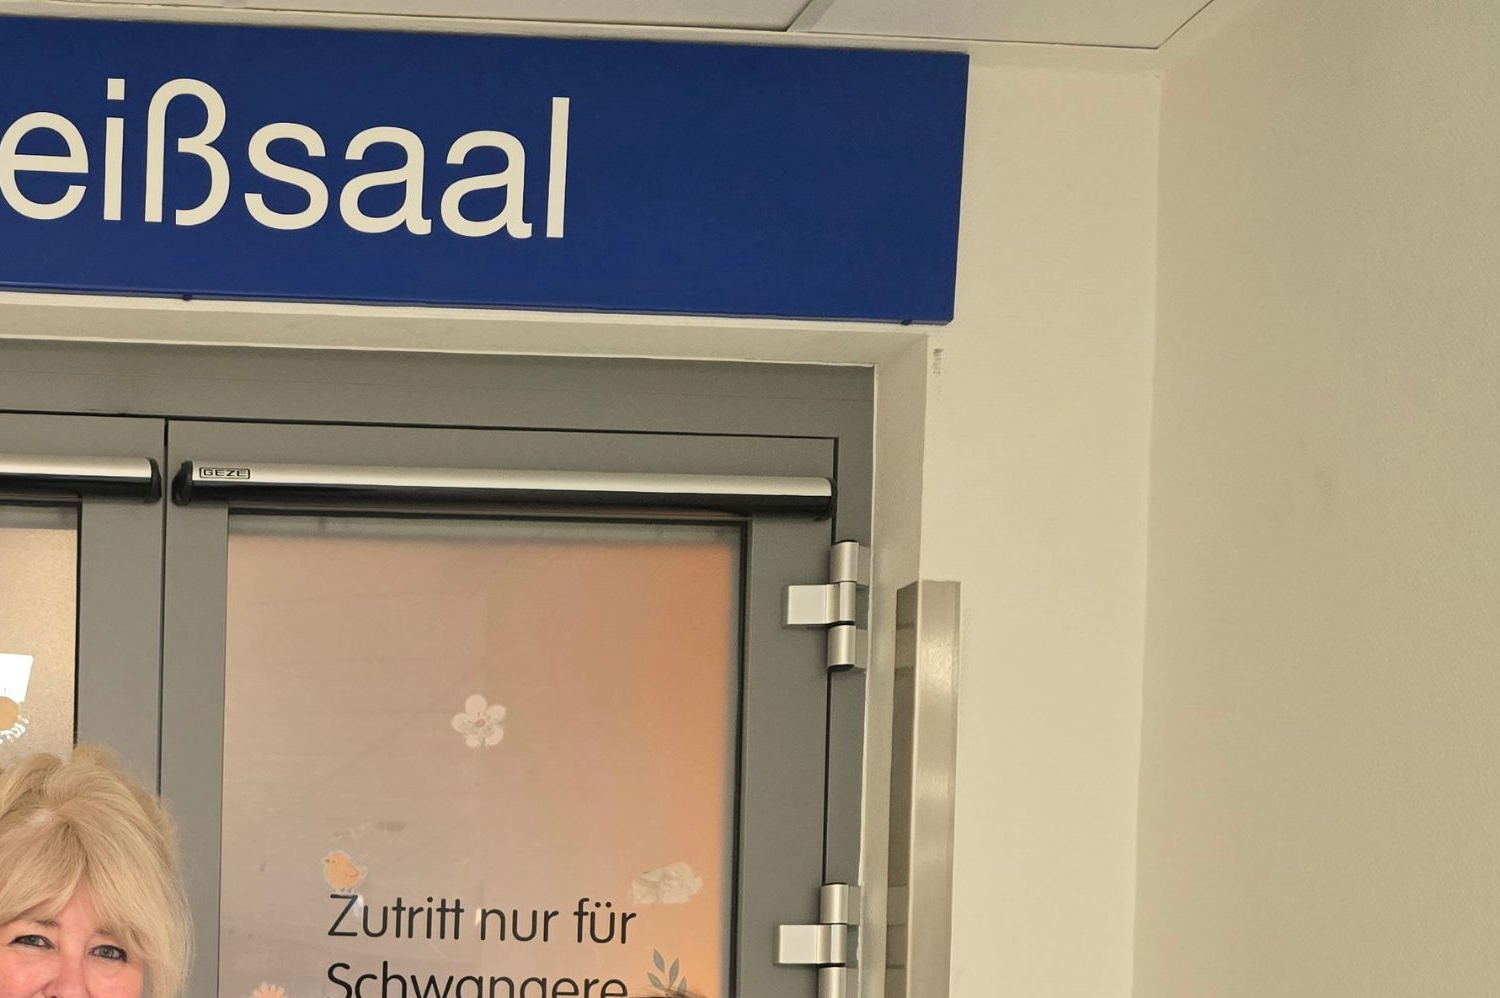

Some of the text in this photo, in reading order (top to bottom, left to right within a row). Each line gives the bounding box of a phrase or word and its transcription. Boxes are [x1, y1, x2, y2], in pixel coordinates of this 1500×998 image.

[203, 469, 247, 477] GEZE
[327, 893, 638, 945] Zutritt nur für
